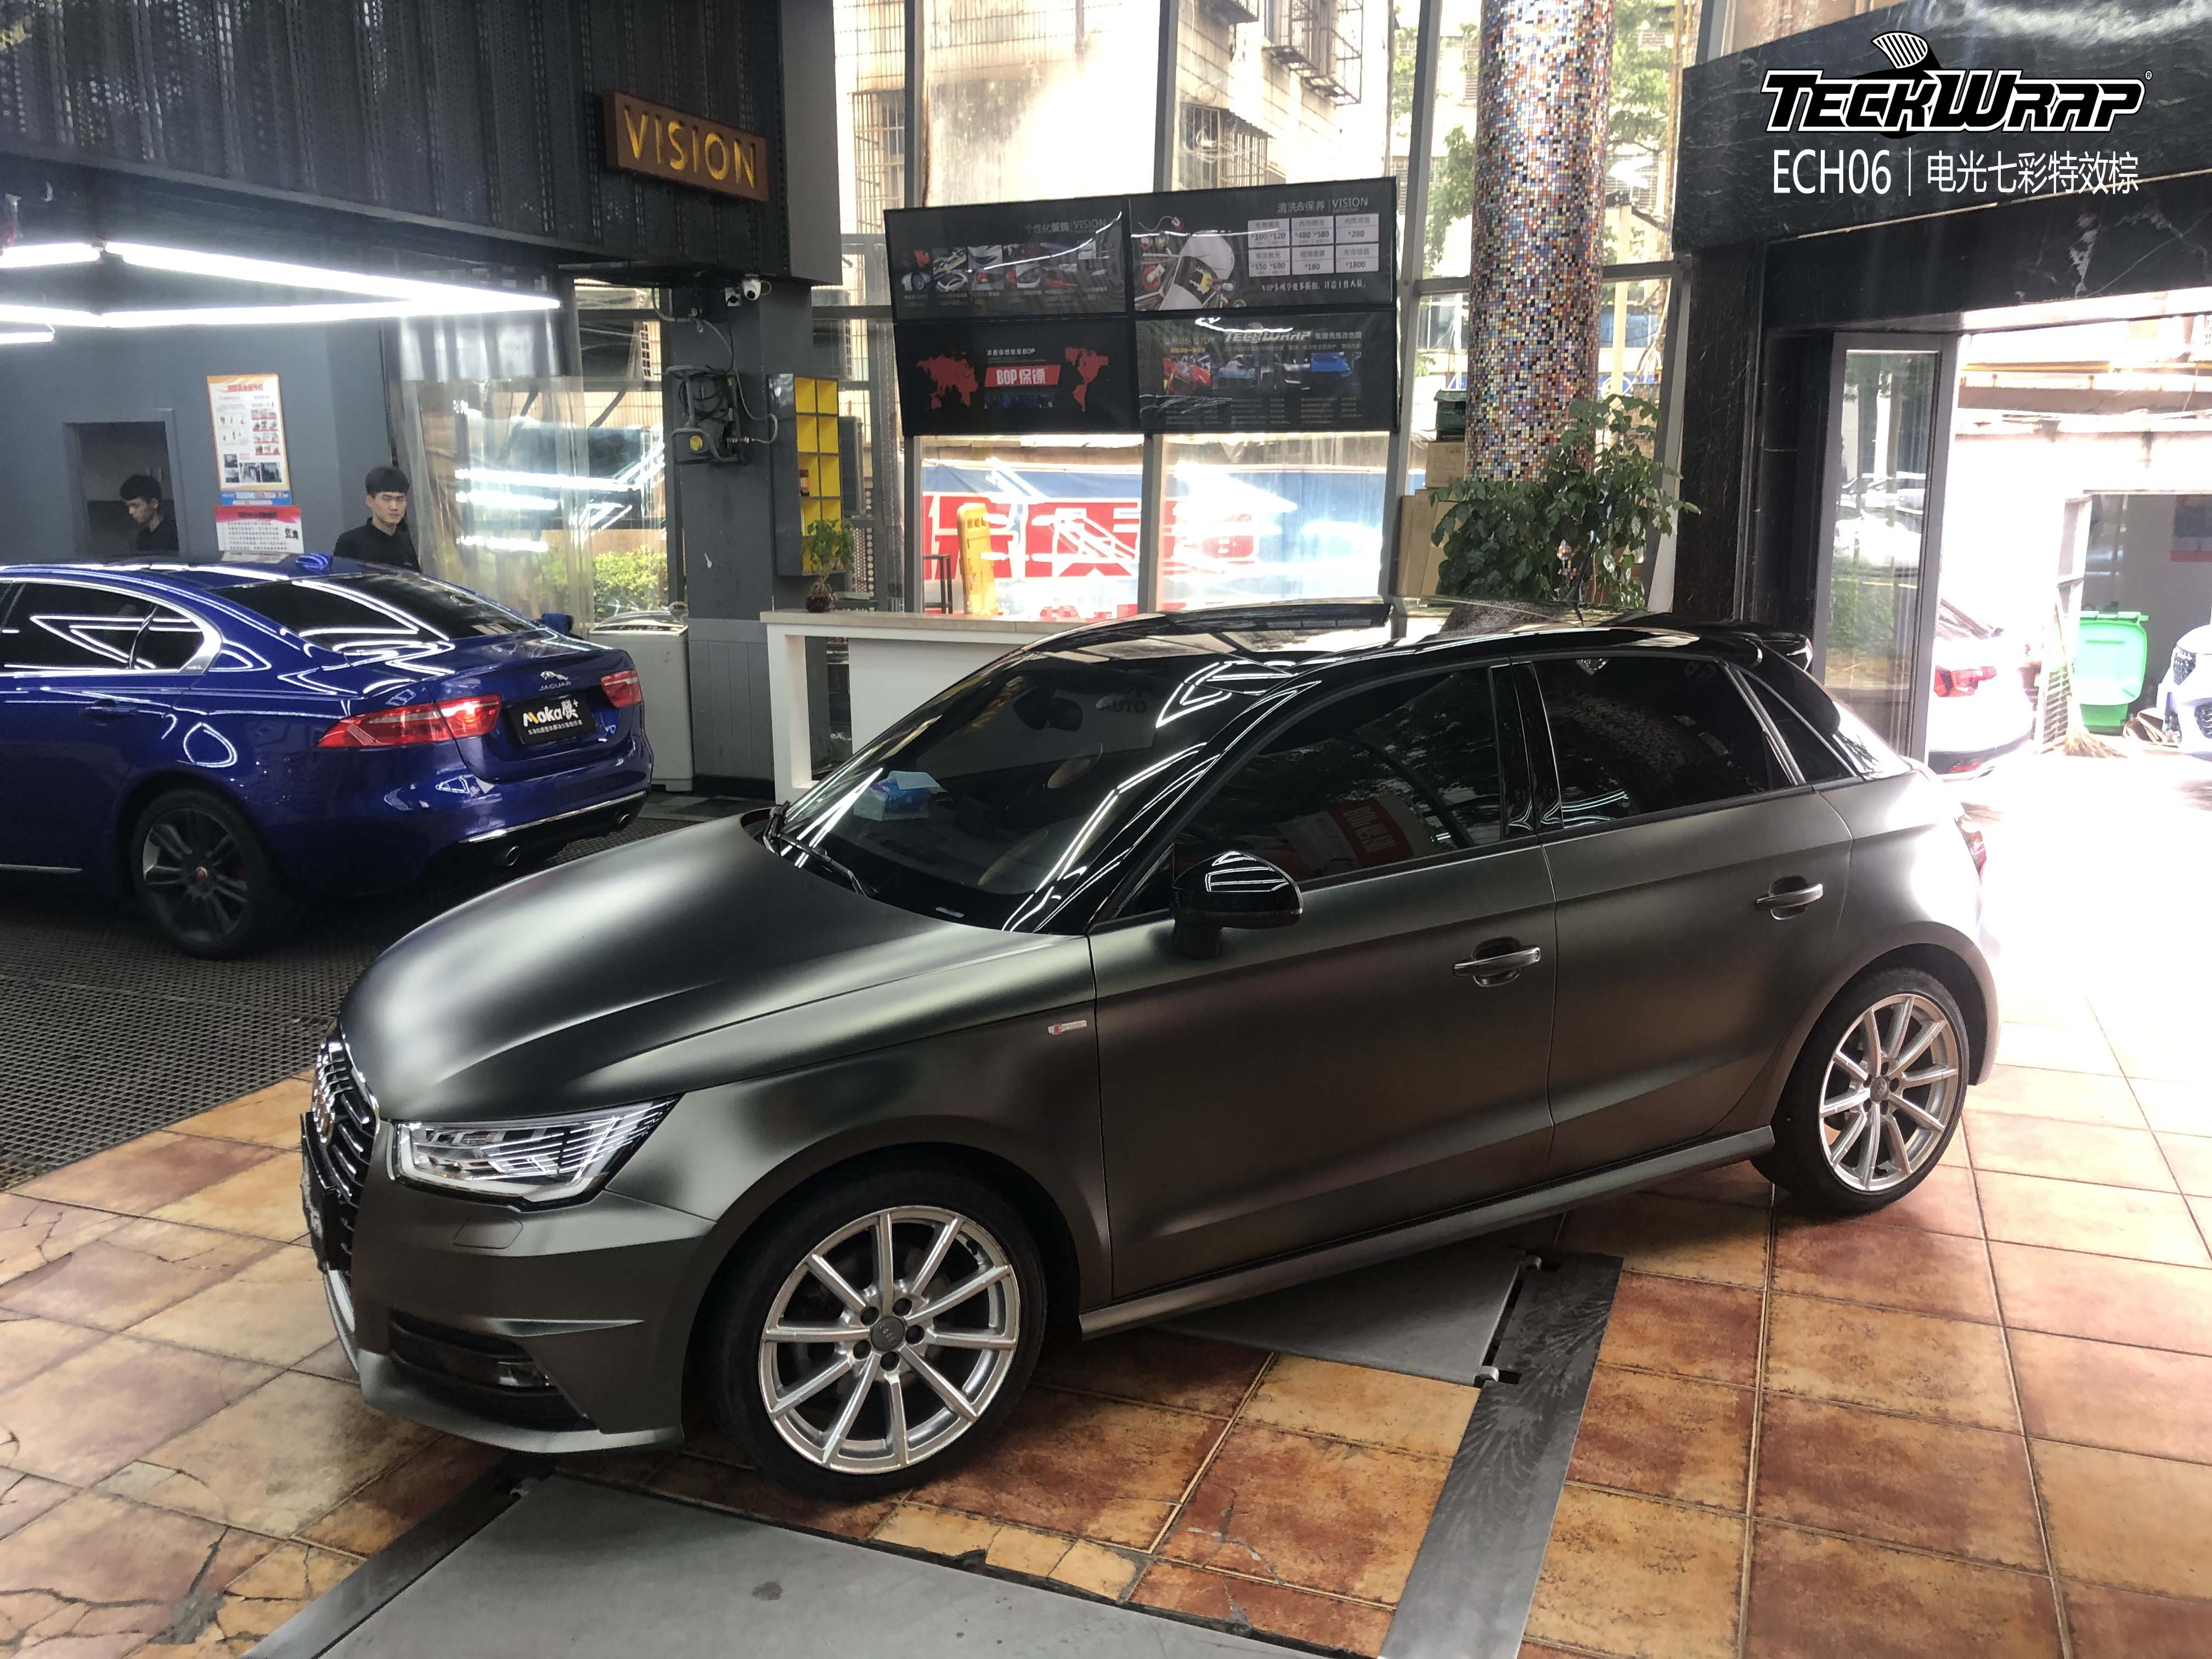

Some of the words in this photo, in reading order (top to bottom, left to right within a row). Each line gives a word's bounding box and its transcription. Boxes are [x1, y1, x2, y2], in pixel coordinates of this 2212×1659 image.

[624, 109, 755, 188] VISION
[1331, 196, 1369, 208] VISION
[1074, 219, 1107, 229] VISION
[996, 369, 1017, 385] BOP
[539, 681, 571, 691] JAGUAR
